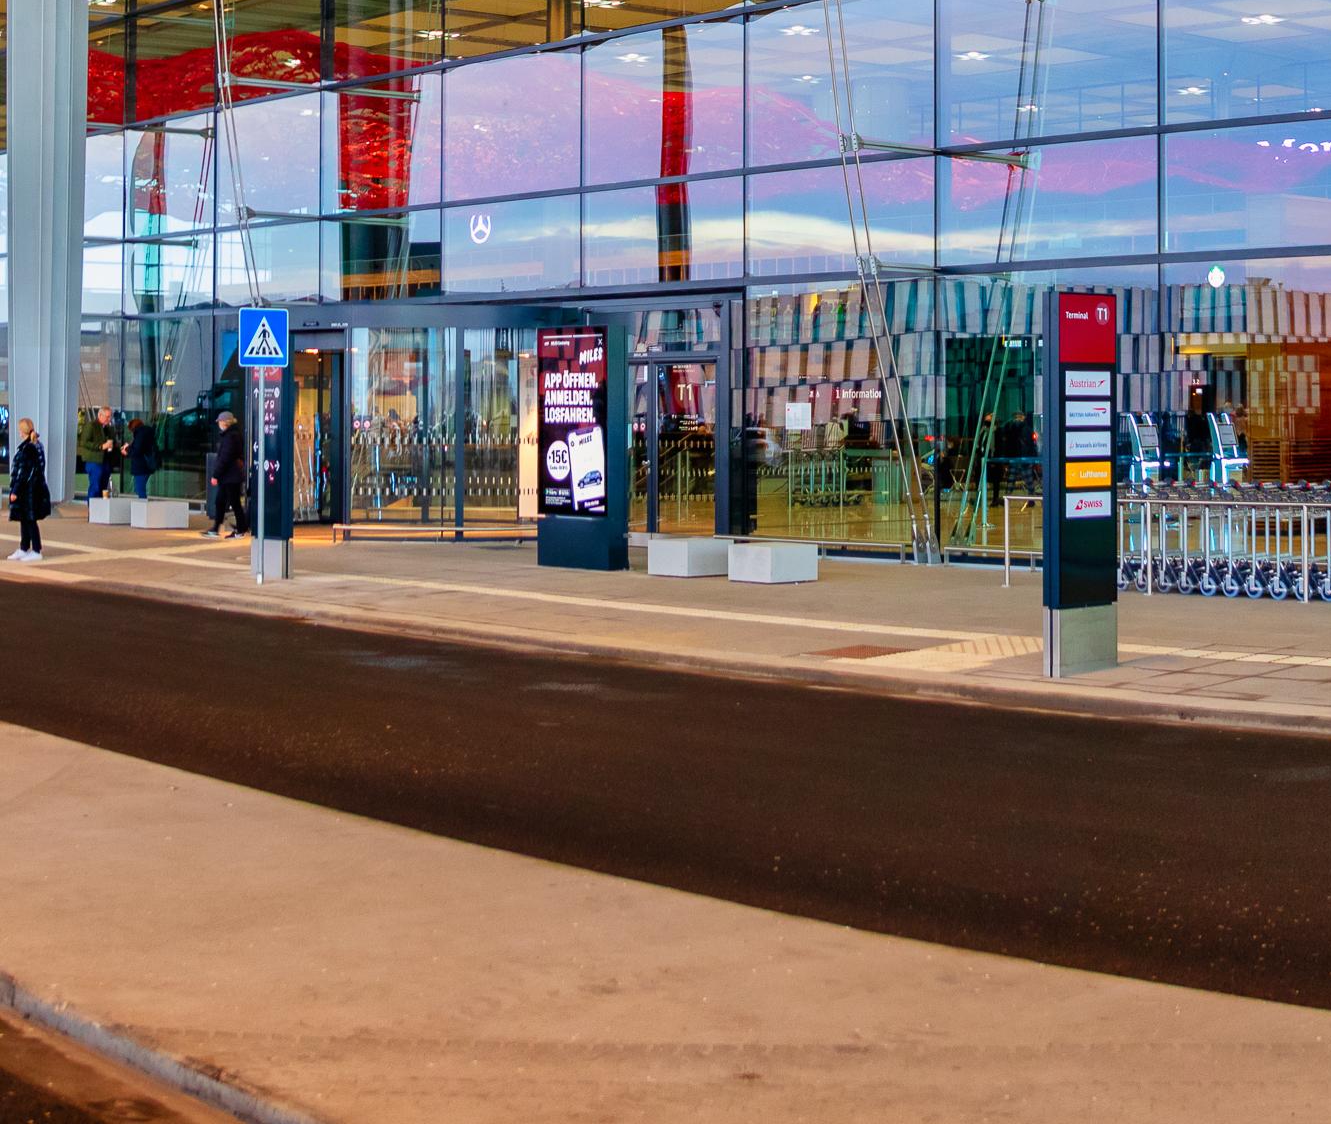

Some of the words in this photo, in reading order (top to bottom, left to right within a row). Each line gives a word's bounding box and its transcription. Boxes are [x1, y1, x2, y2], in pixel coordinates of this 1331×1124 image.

[1066, 311, 1089, 320] Terminal
[1096, 307, 1108, 321] T1
[579, 347, 604, 365] MILES
[544, 372, 562, 389] APP
[562, 369, 599, 389] ÖFFNEN.
[1069, 379, 1097, 388] Austrian
[544, 389, 594, 406] ANMELDEN.
[677, 383, 693, 401] T1
[544, 406, 596, 424] LOSFAHREN.
[1083, 499, 1103, 509] SWISS
